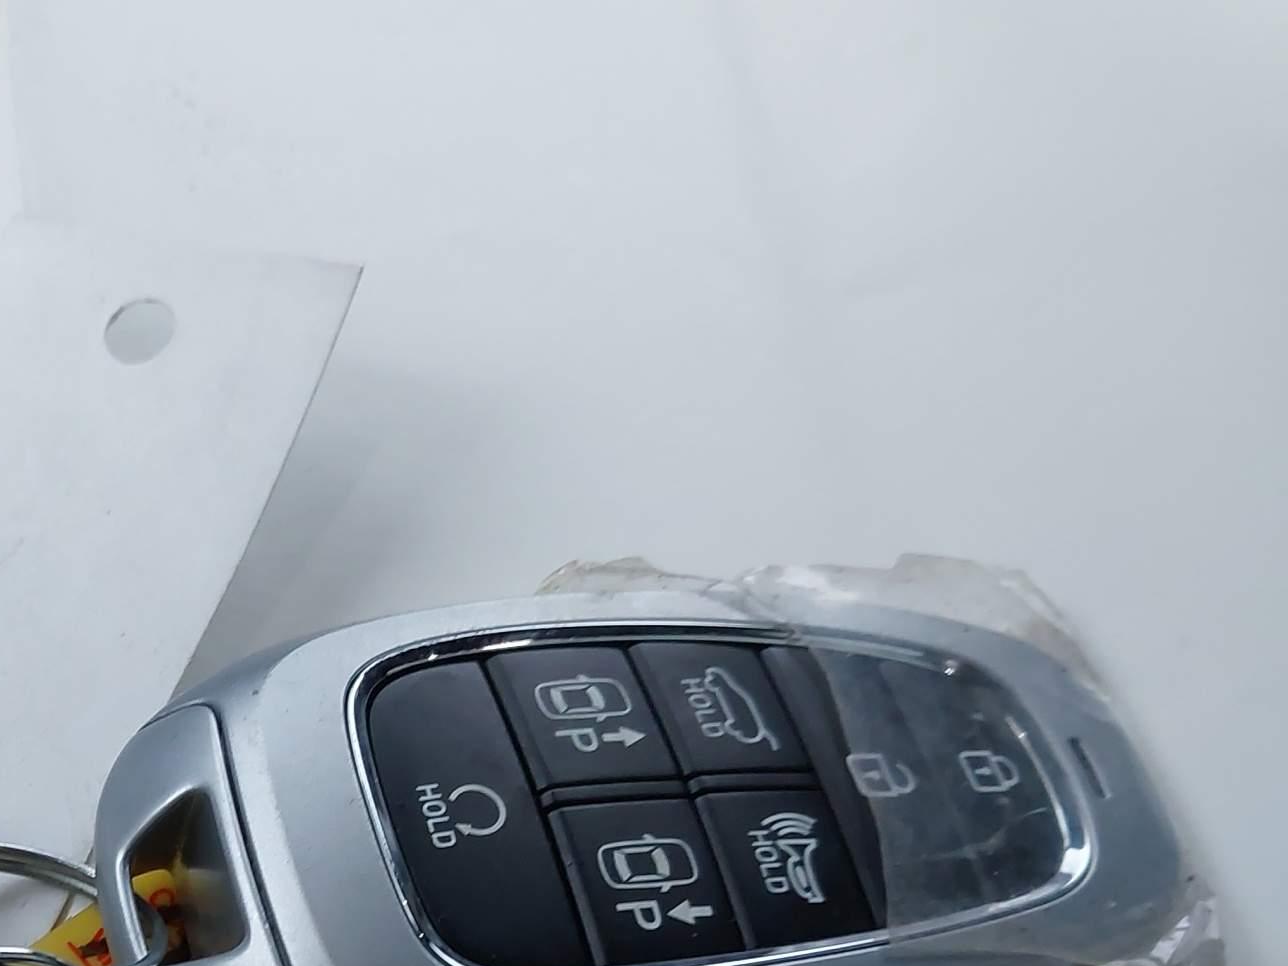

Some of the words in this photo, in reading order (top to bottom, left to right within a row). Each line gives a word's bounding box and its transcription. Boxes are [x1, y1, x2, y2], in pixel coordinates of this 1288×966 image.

[679, 677, 726, 738] HOLD
[554, 727, 600, 753] P
[415, 782, 457, 849] HOLD
[746, 829, 790, 894] HOLD
[615, 899, 663, 931] P
